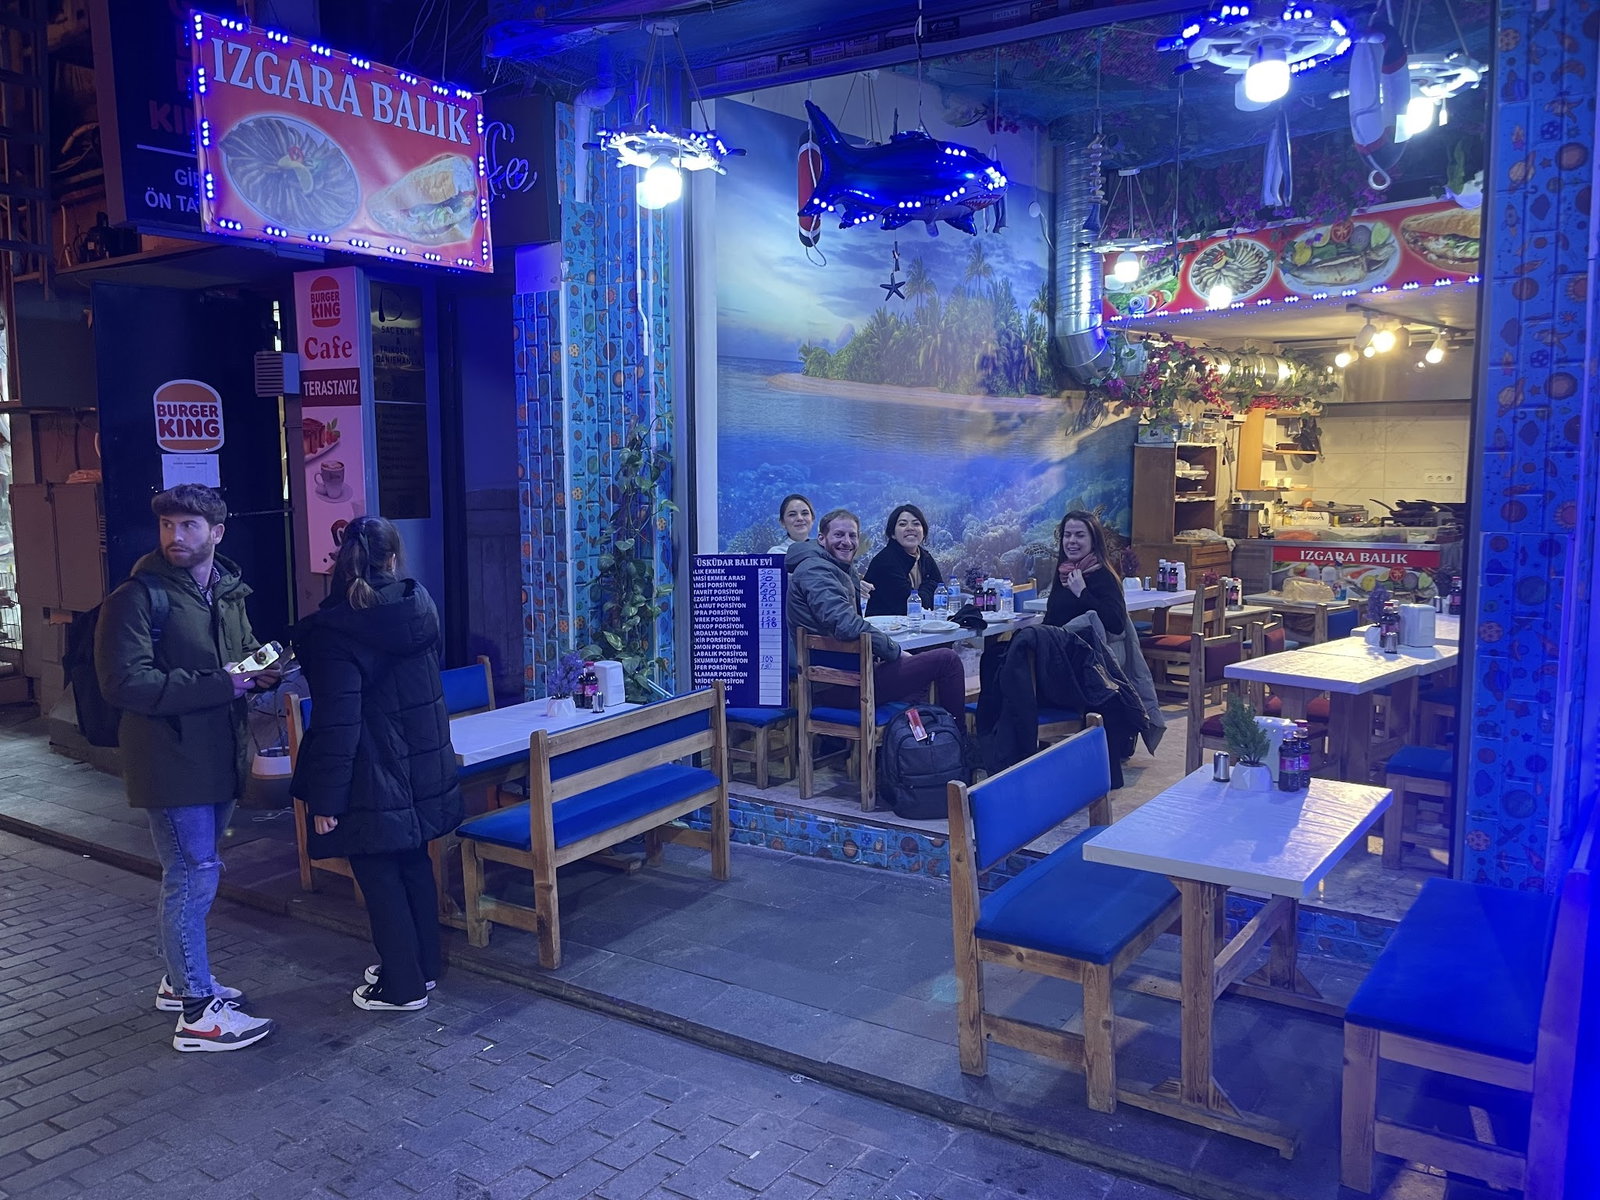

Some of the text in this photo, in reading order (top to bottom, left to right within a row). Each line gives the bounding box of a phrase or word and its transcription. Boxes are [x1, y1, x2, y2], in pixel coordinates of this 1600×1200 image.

[211, 38, 363, 118] IZGARA
[370, 81, 471, 145] BALIK
[145, 187, 172, 210] ÖN
[310, 291, 340, 303] BURGER
[311, 302, 341, 319] KING
[304, 335, 352, 360] Cafe
[303, 379, 358, 396] TERASTAYIZ
[156, 404, 219, 418] BURGER
[158, 418, 220, 438] KING
[697, 558, 734, 566] ÜSKÜDAR
[760, 557, 772, 566] EVİ
[1300, 550, 1408, 564] IZGARA BALIK
